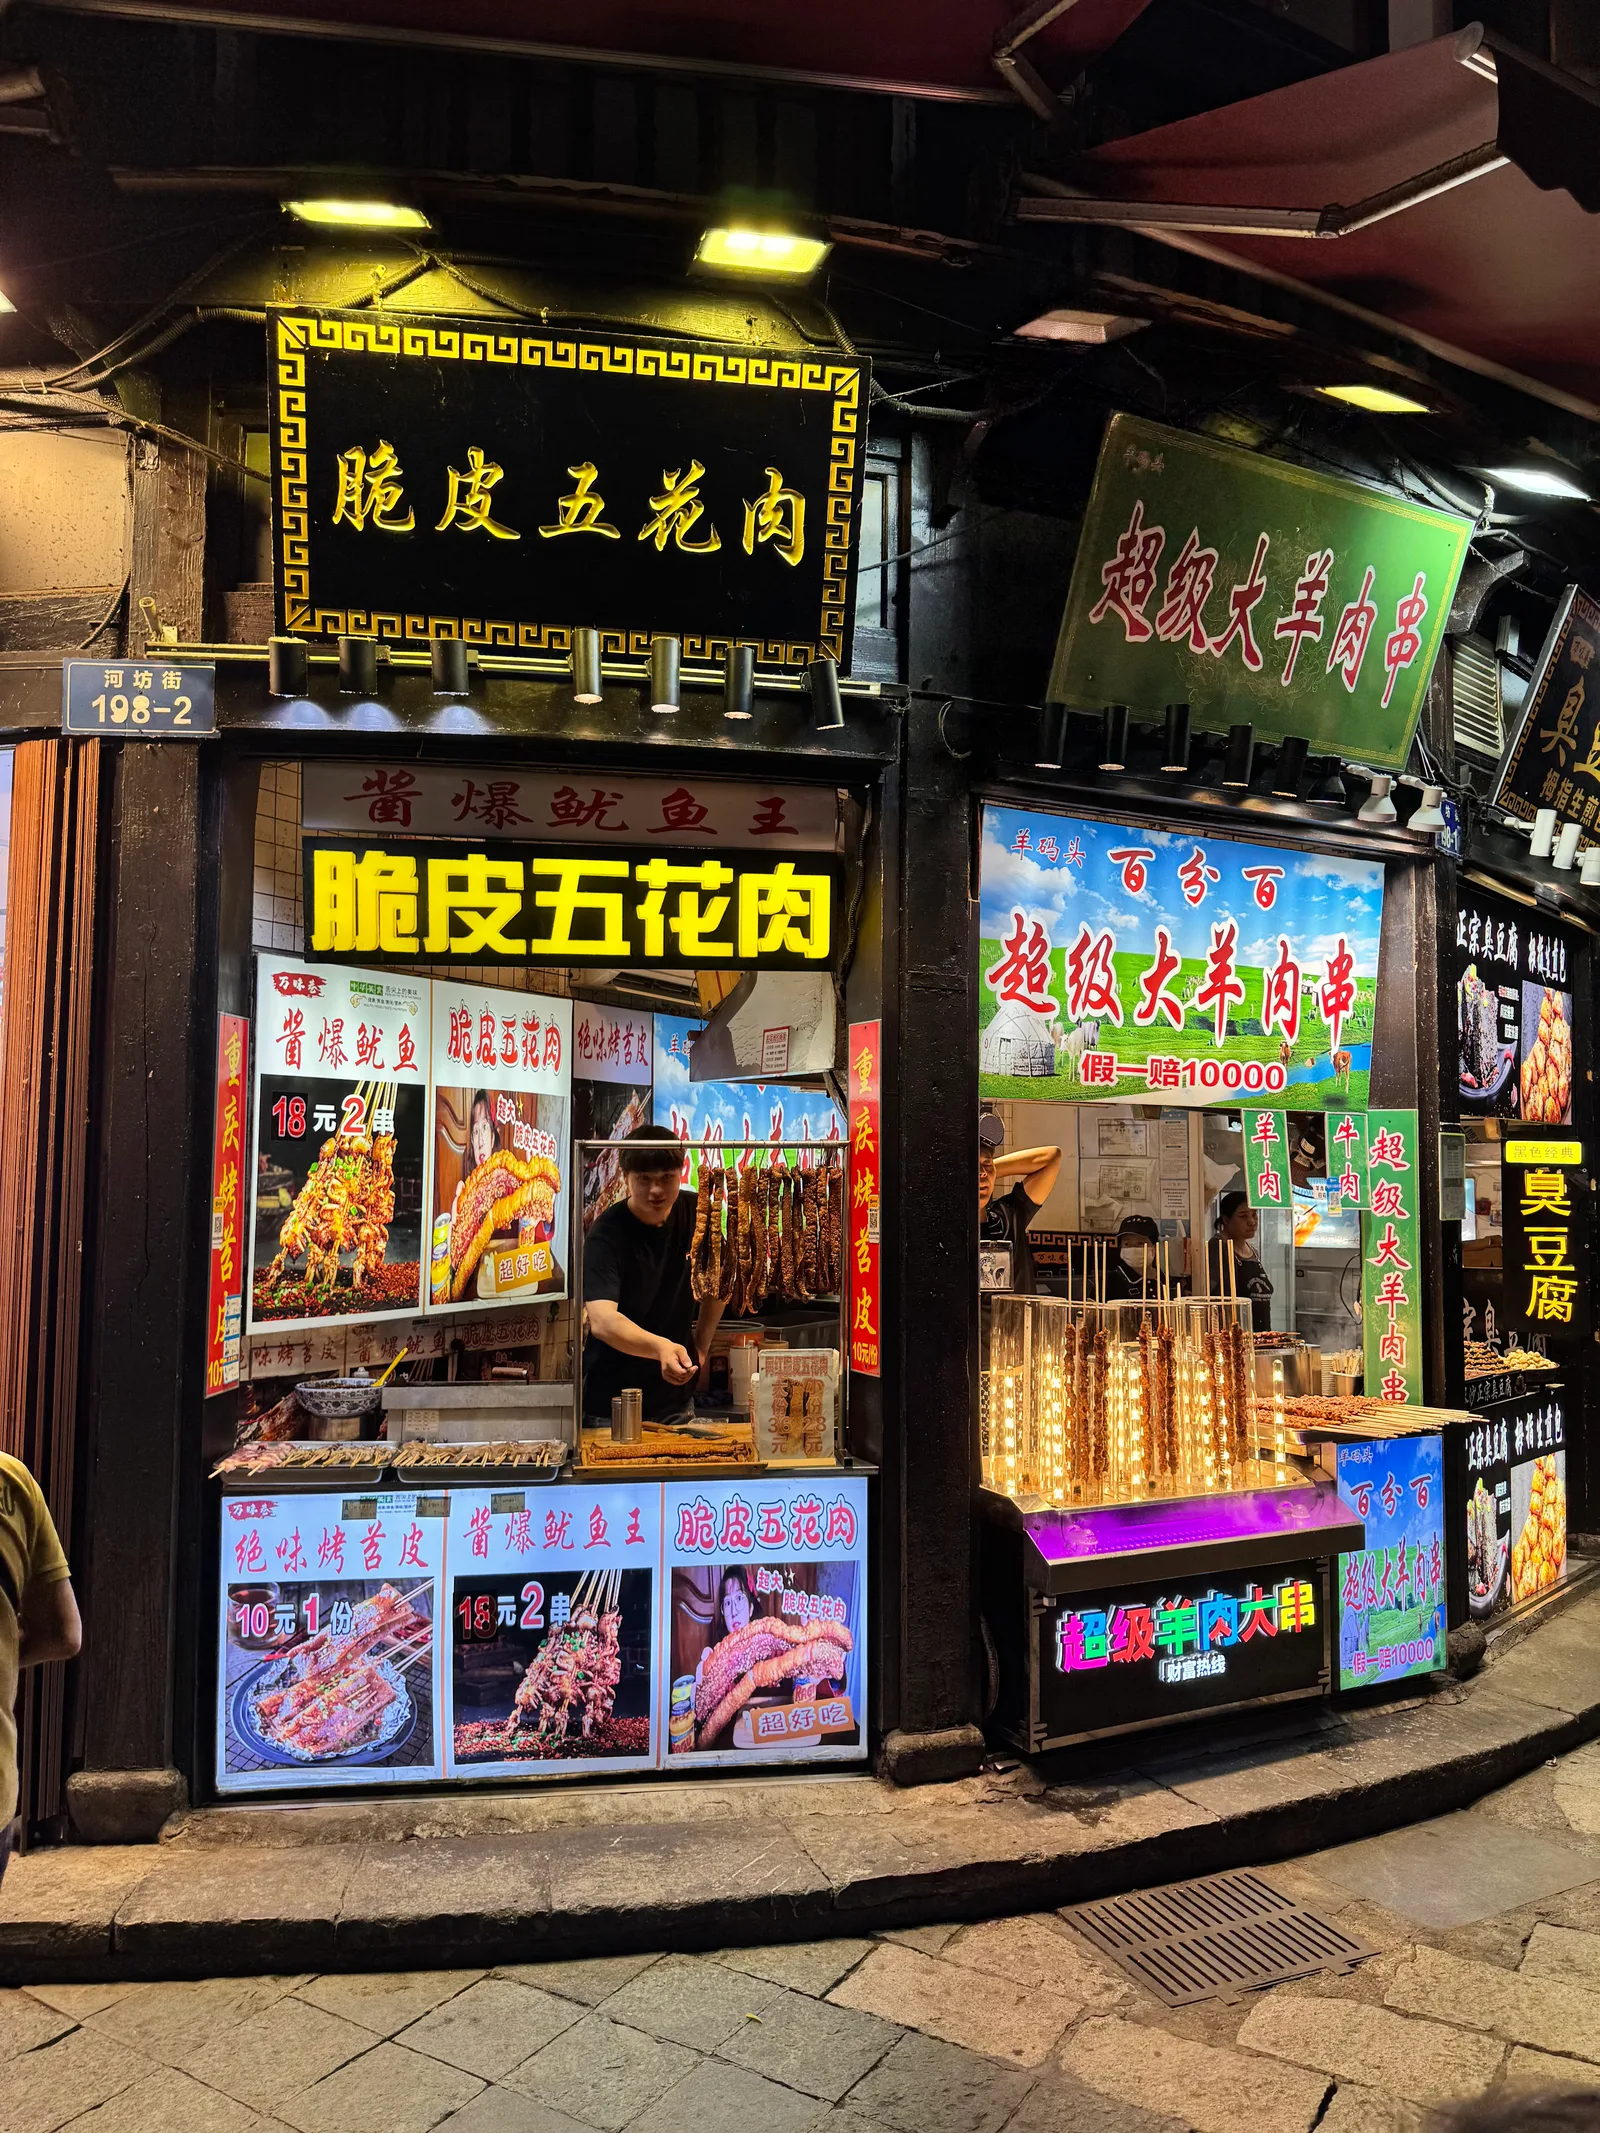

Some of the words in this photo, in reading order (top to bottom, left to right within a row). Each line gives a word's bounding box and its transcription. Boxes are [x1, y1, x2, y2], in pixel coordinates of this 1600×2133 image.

[332, 438, 806, 567] 脆皮五花肉
[1088, 500, 1428, 709] 超级大羊肉串
[103, 669, 183, 692] 河坊街
[91, 694, 193, 727] 198-2
[344, 768, 800, 836] 酱爆鱿鱼王
[1540, 768, 1600, 830] 拇指生煎
[1010, 827, 1087, 868] 羊码头
[311, 850, 831, 960] 脆皮五花肉
[1108, 846, 1287, 911] 百分百
[1457, 909, 1518, 971] 正宗臭豆腐
[984, 905, 1359, 1053] 超级大羊肉串
[275, 1007, 420, 1074] 酱爆鱿鱼
[448, 1000, 563, 1077] 脆皮五花肉
[577, 1019, 650, 1069] 绝味烤苕皮
[1079, 1050, 1288, 1093] 假一赔10000
[272, 1093, 396, 1138] 18元2串
[496, 1094, 517, 1126] 超大
[513, 1120, 557, 1162] 脆皮五花肉
[1251, 1112, 1282, 1203] 羊肉
[1333, 1115, 1361, 1204] 牛肉
[1513, 1145, 1574, 1158] 黑色经典
[853, 1047, 877, 1336] 重庆烤苕皮
[499, 1250, 548, 1284] 超好吃
[1366, 1126, 1412, 1402] 超级大羊肉串
[1520, 1169, 1578, 1323] 臭豆腐
[852, 1342, 878, 1367] 10元/份
[1339, 1447, 1373, 1467] 羊码头
[1466, 1417, 1508, 1471] 正宗臭豆腐
[1350, 1472, 1432, 1518] 百分百
[234, 1520, 430, 1575] 绝味烤苕皮
[463, 1504, 646, 1559] 酱爆鱿鱼王
[674, 1493, 859, 1555] 脆皮五花肉
[756, 1567, 784, 1595] 超大
[1342, 1532, 1442, 1615] 超级大羊肉串
[235, 1592, 354, 1638] 10元1份
[782, 1590, 846, 1624] 脆皮五花肉
[1057, 1577, 1316, 1674] 超级羊肉大串
[1162, 1653, 1226, 1683] 财富热线
[1353, 1638, 1433, 1677] 假一赔10000
[759, 1702, 849, 1737] 超好吃
